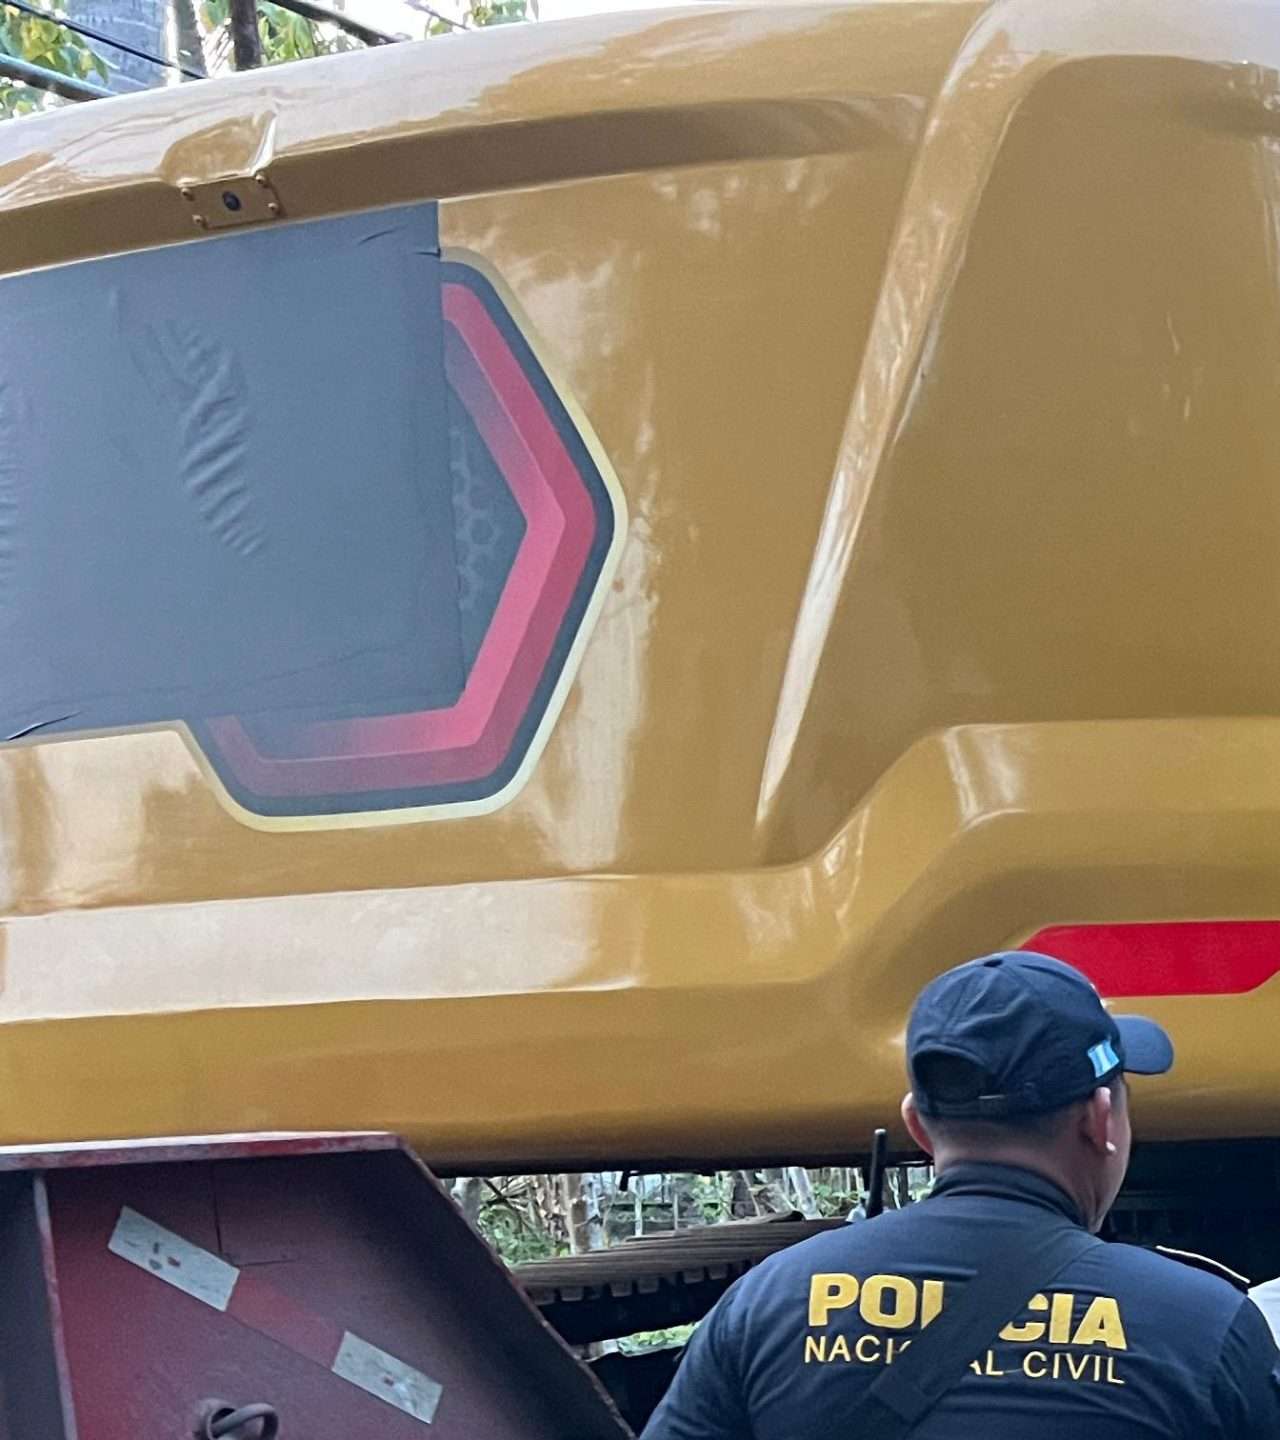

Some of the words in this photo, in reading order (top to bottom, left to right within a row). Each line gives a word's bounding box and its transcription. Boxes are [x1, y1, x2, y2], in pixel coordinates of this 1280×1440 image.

[807, 1272, 1127, 1350] POCIA
[804, 1335, 1003, 1376] NACIL
[1022, 1350, 1125, 1384] CIVIL
